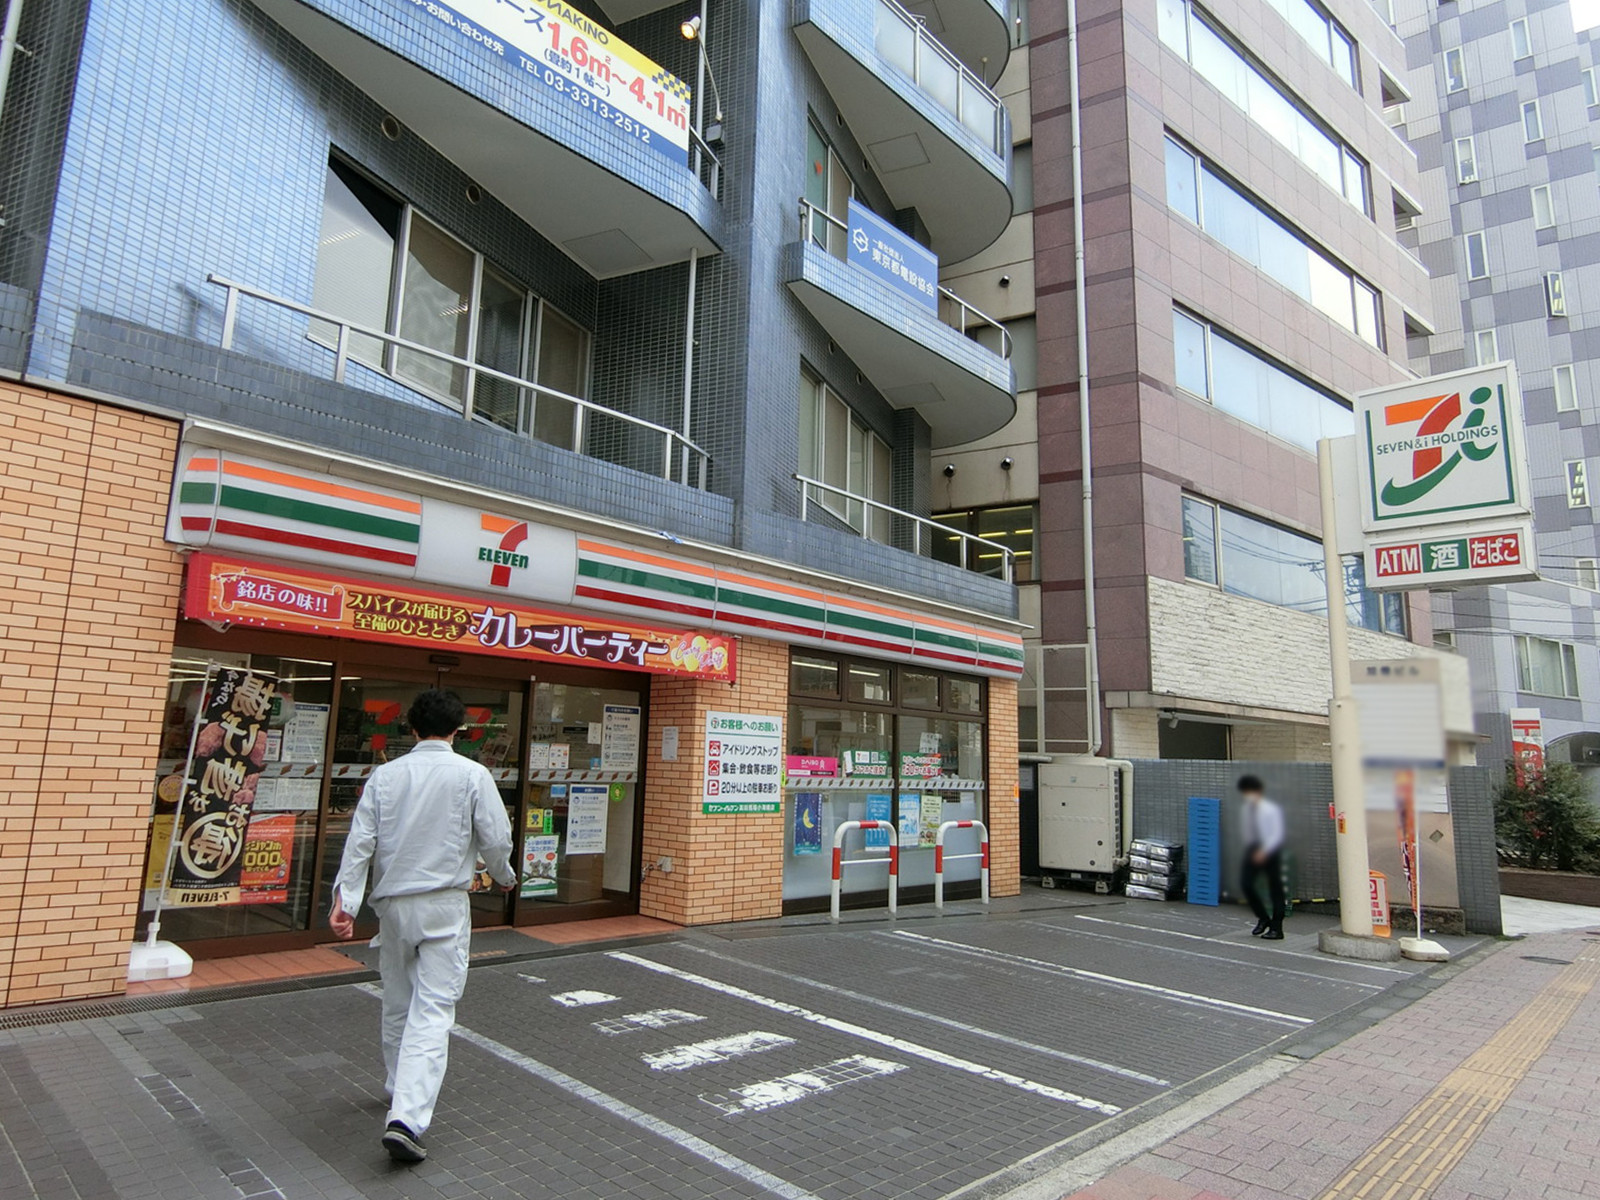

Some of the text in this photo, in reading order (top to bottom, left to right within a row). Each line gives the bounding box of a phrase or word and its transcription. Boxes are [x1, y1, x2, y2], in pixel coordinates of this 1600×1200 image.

[519, 55, 541, 78] TEL
[544, 69, 651, 144] 03-3313-2512
[1432, 425, 1498, 446] HOLDINGS
[1378, 537, 1519, 575] ATM 酒 たばこ
[236, 580, 328, 613] 銘店の味!!
[347, 592, 468, 624] スパイスが届ける
[353, 612, 461, 641] 至福のひととき
[469, 606, 670, 667] カレーパーティー
[721, 719, 779, 732] お客様へのお願い
[722, 744, 779, 757] アイドリングストップ
[721, 782, 778, 794] 20分以上の駐車お断り
